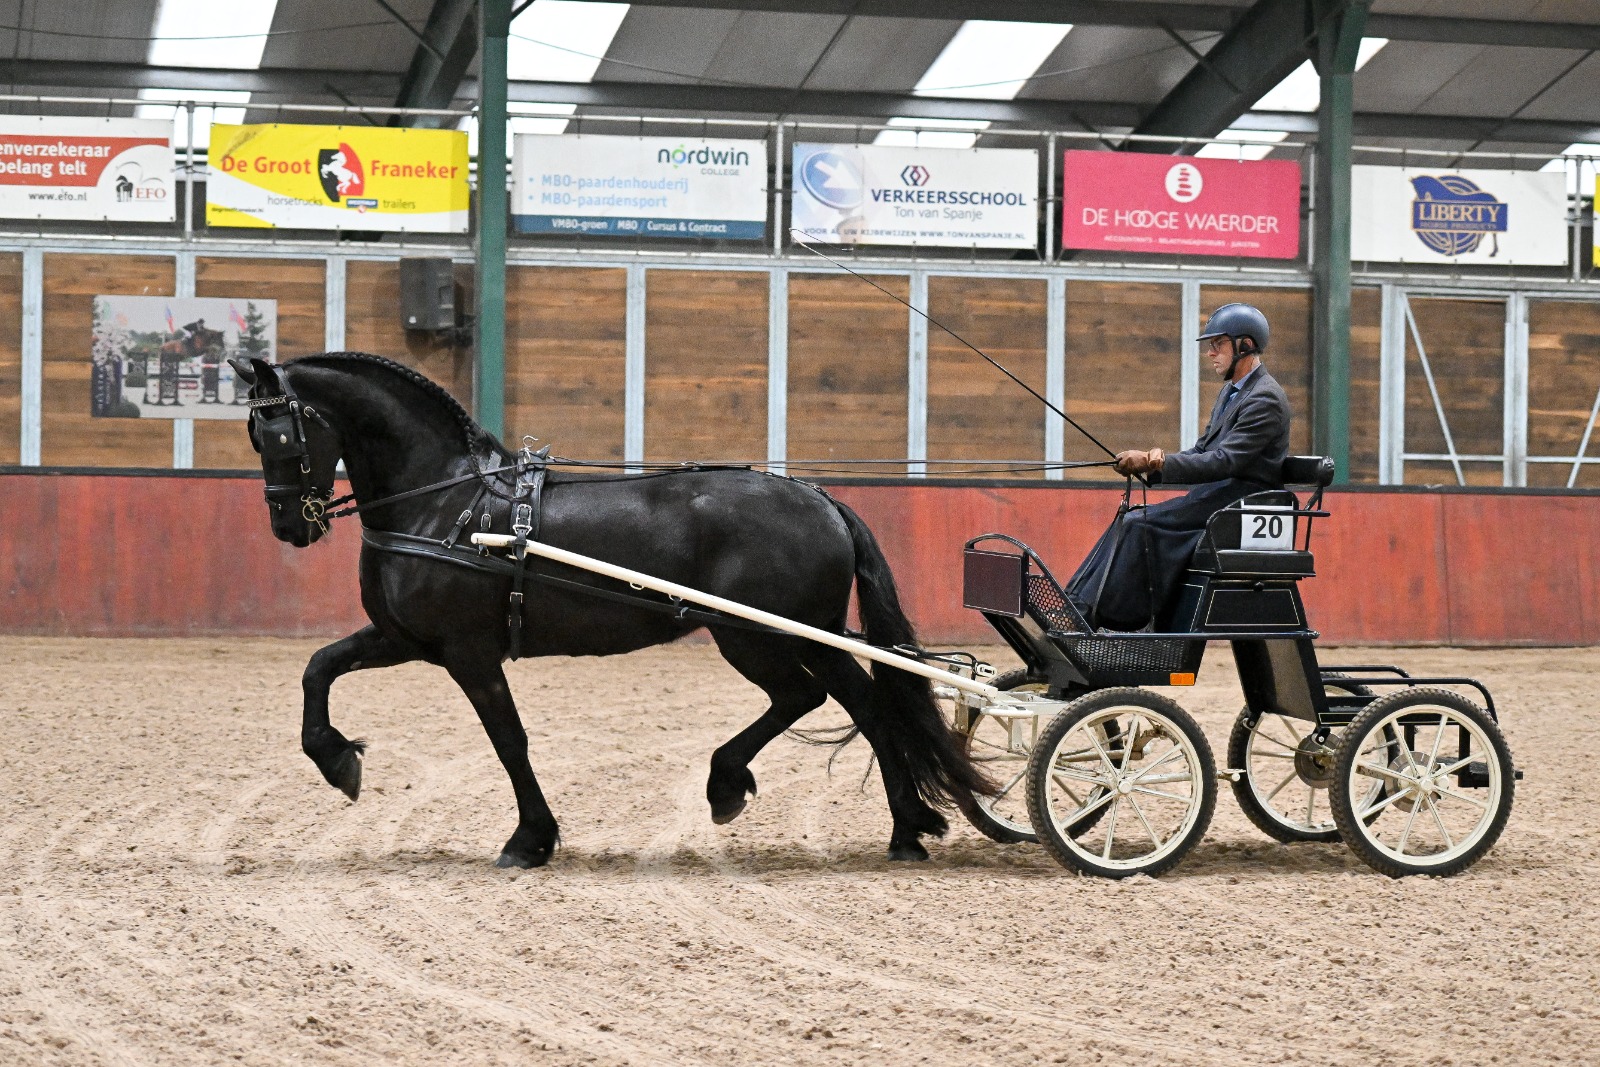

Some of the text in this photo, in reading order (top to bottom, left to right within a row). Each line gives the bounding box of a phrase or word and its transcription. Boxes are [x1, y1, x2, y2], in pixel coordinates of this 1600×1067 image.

[658, 146, 749, 166] nordwin
[59, 161, 87, 175] telt
[221, 155, 458, 179] De Groot Franeker
[700, 167, 740, 176] COLLEGE
[541, 174, 689, 194] MBO-paardenhouderij
[28, 189, 87, 201] www.efo.nl
[135, 187, 167, 199] EFO
[541, 192, 668, 208] MBO-paardensport
[871, 188, 1027, 206] VERKEERSSCHOOL
[267, 195, 323, 206] horsetrucks
[382, 199, 416, 209] trailers
[894, 206, 983, 222] Ton van Spanje
[1082, 207, 1279, 233] DE HOOGE WAERDER
[1418, 204, 1500, 222] LIBERTY
[617, 220, 638, 230] MBO
[647, 220, 677, 232] Cursus
[688, 221, 727, 233] Contract
[1252, 516, 1283, 539] 20
